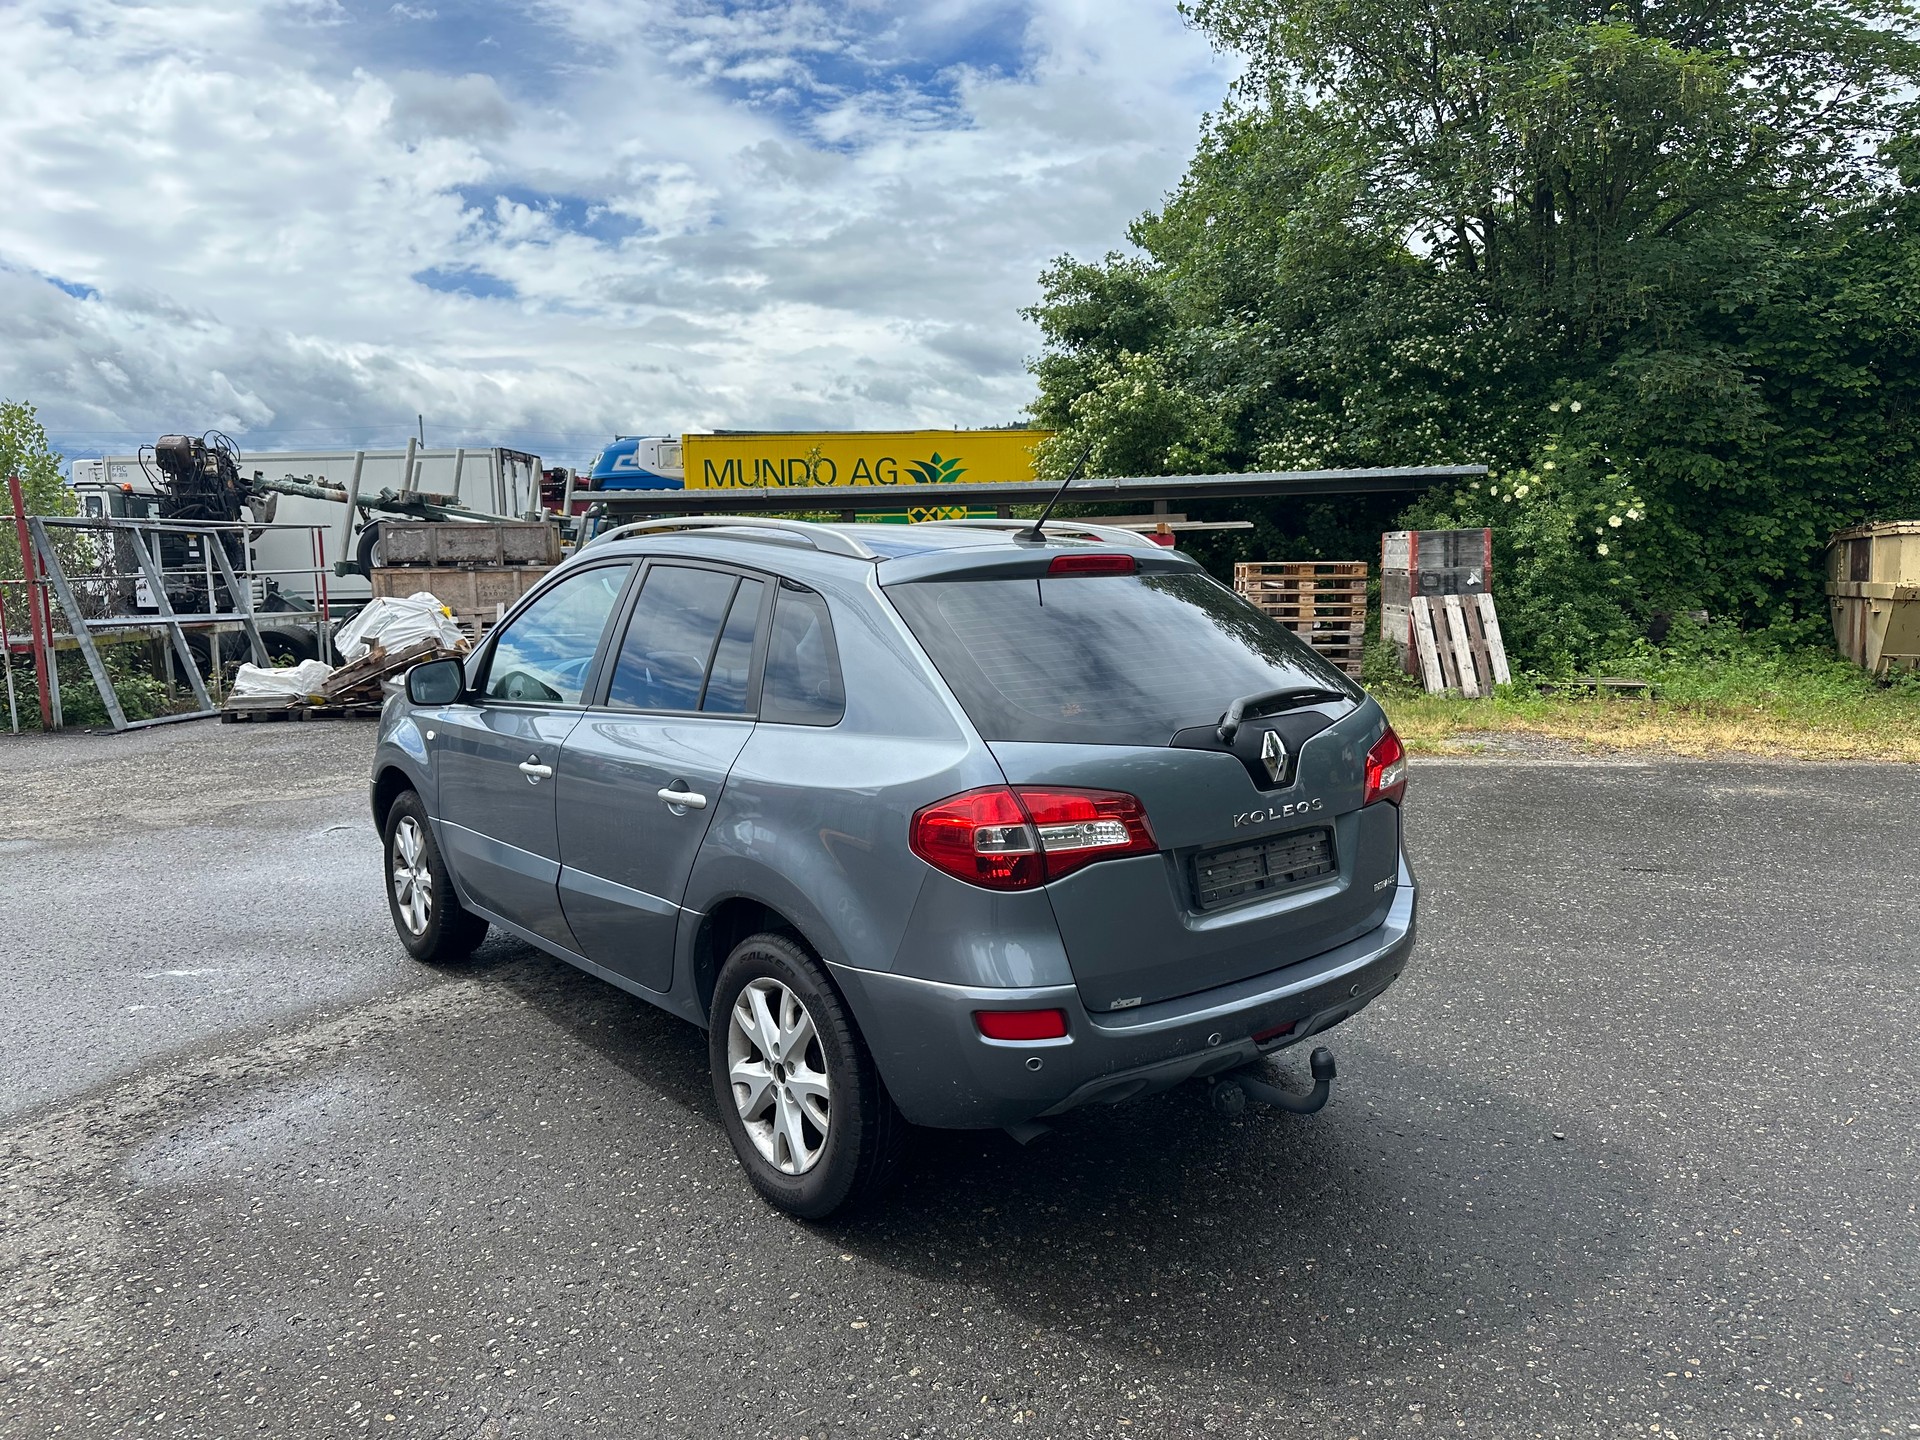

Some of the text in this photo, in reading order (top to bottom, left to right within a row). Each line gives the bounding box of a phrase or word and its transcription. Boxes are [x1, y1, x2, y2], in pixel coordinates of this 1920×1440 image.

[111, 465, 127, 473] FRC
[703, 456, 898, 487] MUNDO AG
[1232, 797, 1324, 828] KOLEOS
